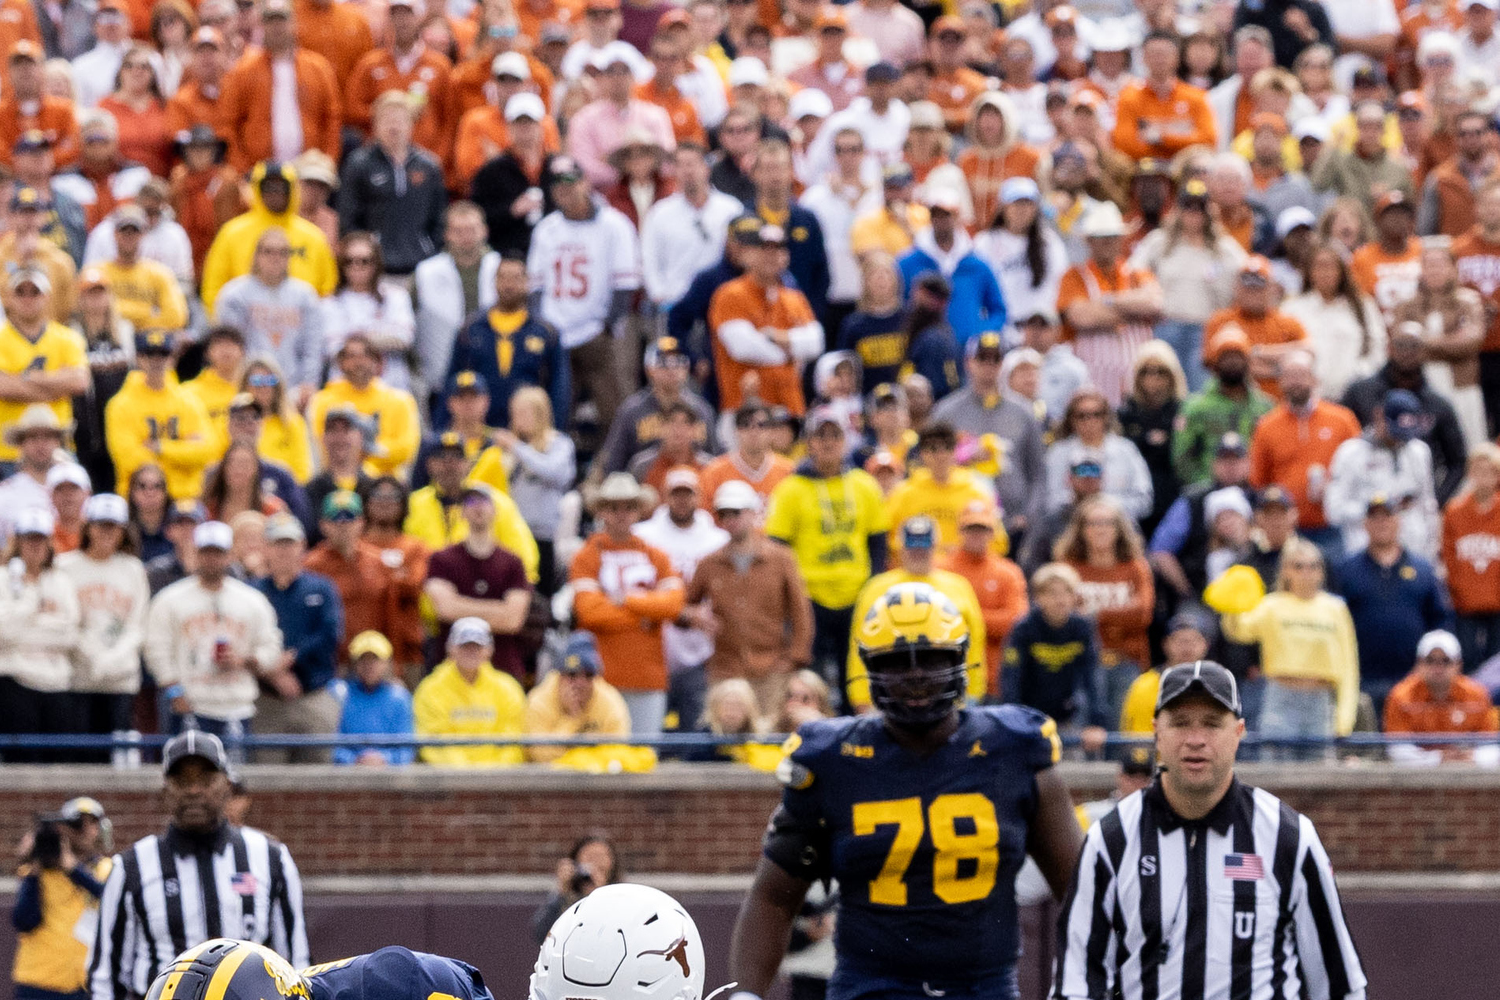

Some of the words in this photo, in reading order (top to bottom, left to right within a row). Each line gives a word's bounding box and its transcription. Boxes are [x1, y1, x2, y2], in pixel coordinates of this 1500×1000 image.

[553, 254, 588, 300] 15
[852, 792, 999, 906] 78
[1140, 855, 1157, 876] S
[1234, 911, 1256, 940] U
